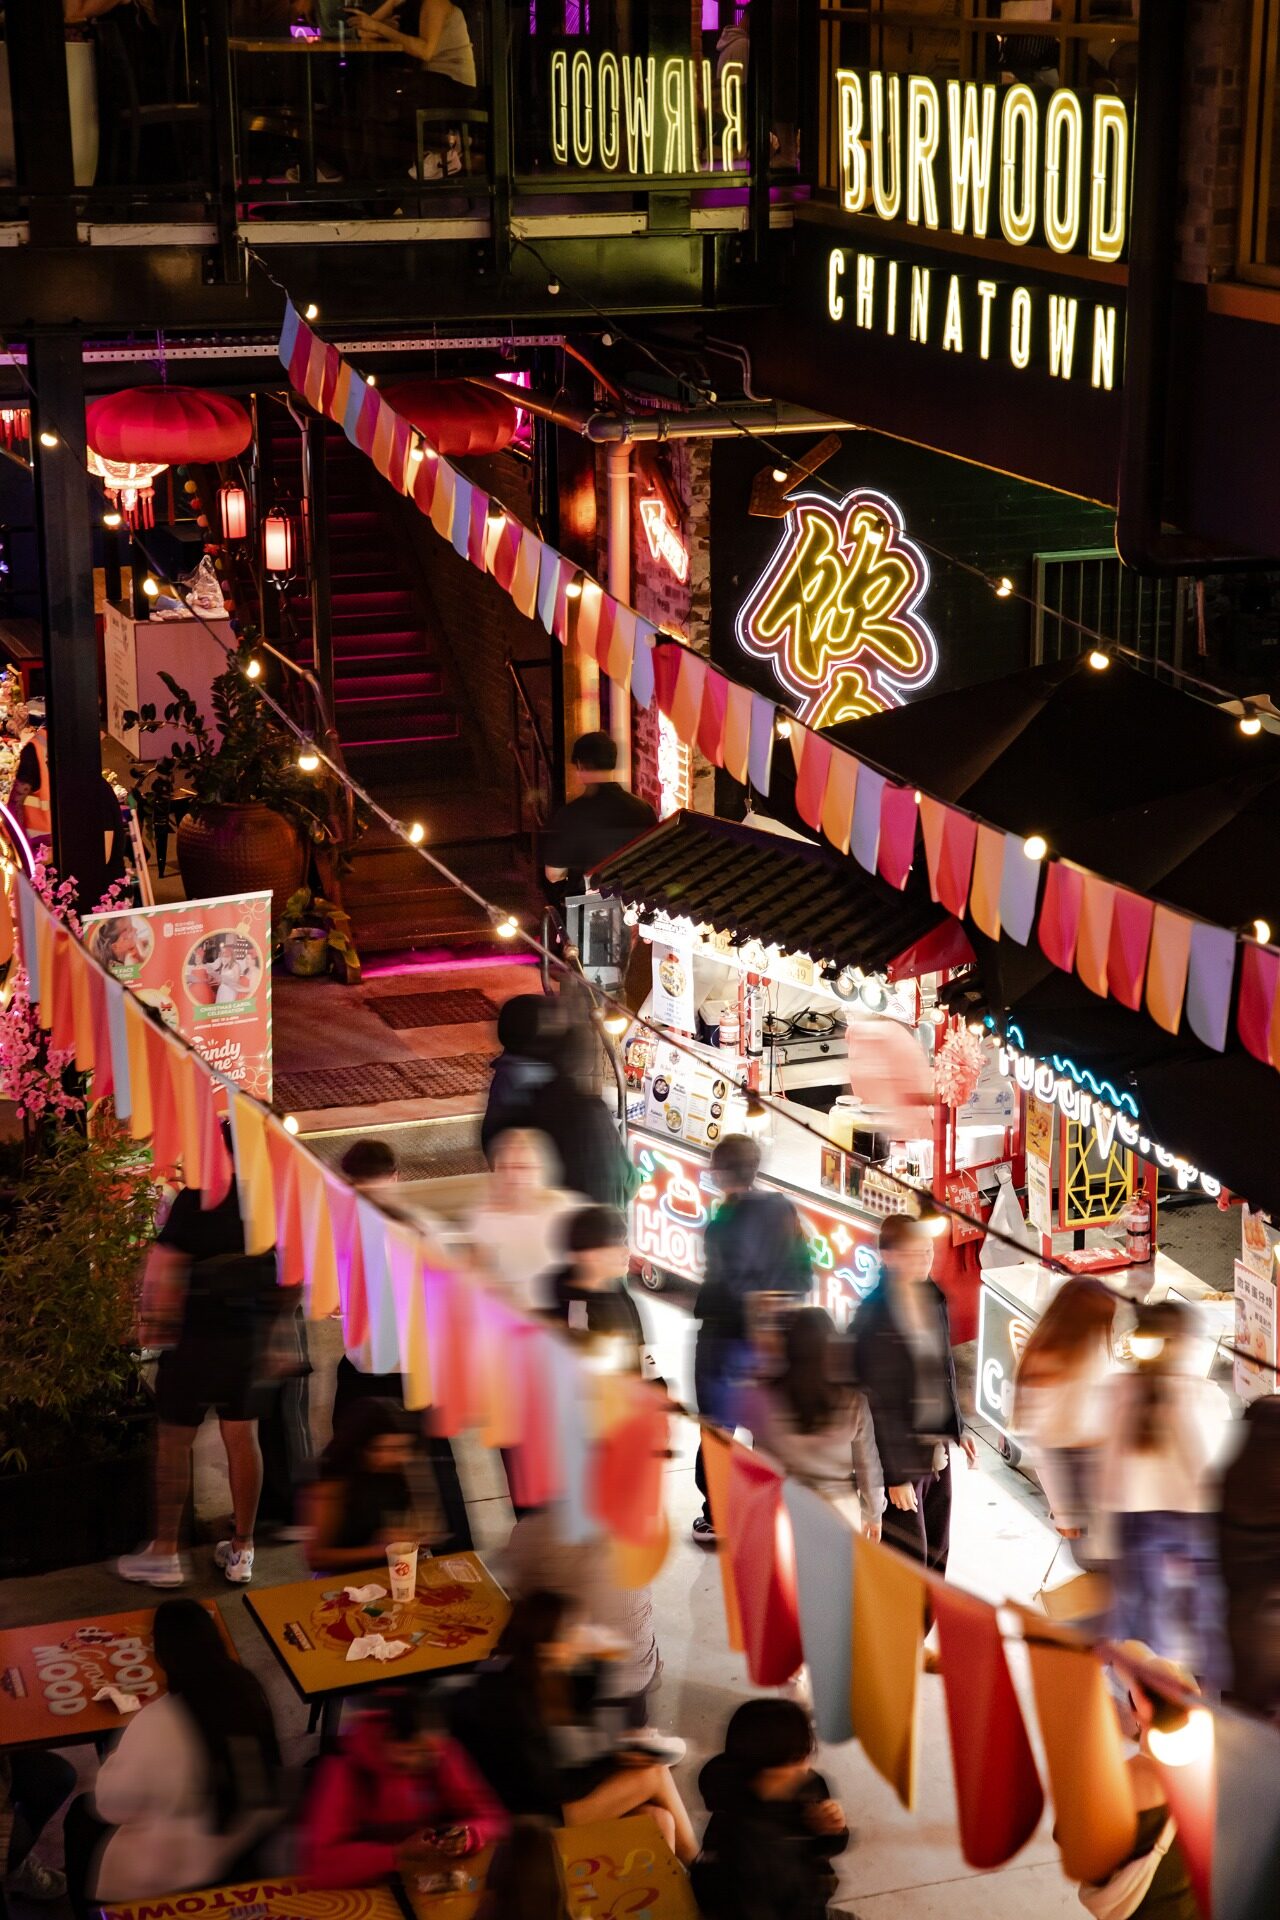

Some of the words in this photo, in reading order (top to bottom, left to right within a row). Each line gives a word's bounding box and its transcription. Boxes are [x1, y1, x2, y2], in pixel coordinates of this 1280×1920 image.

[837, 69, 1128, 263] BURWOOD
[828, 248, 1116, 391] CHINATOWN
[31, 1644, 88, 1716] MOOD
